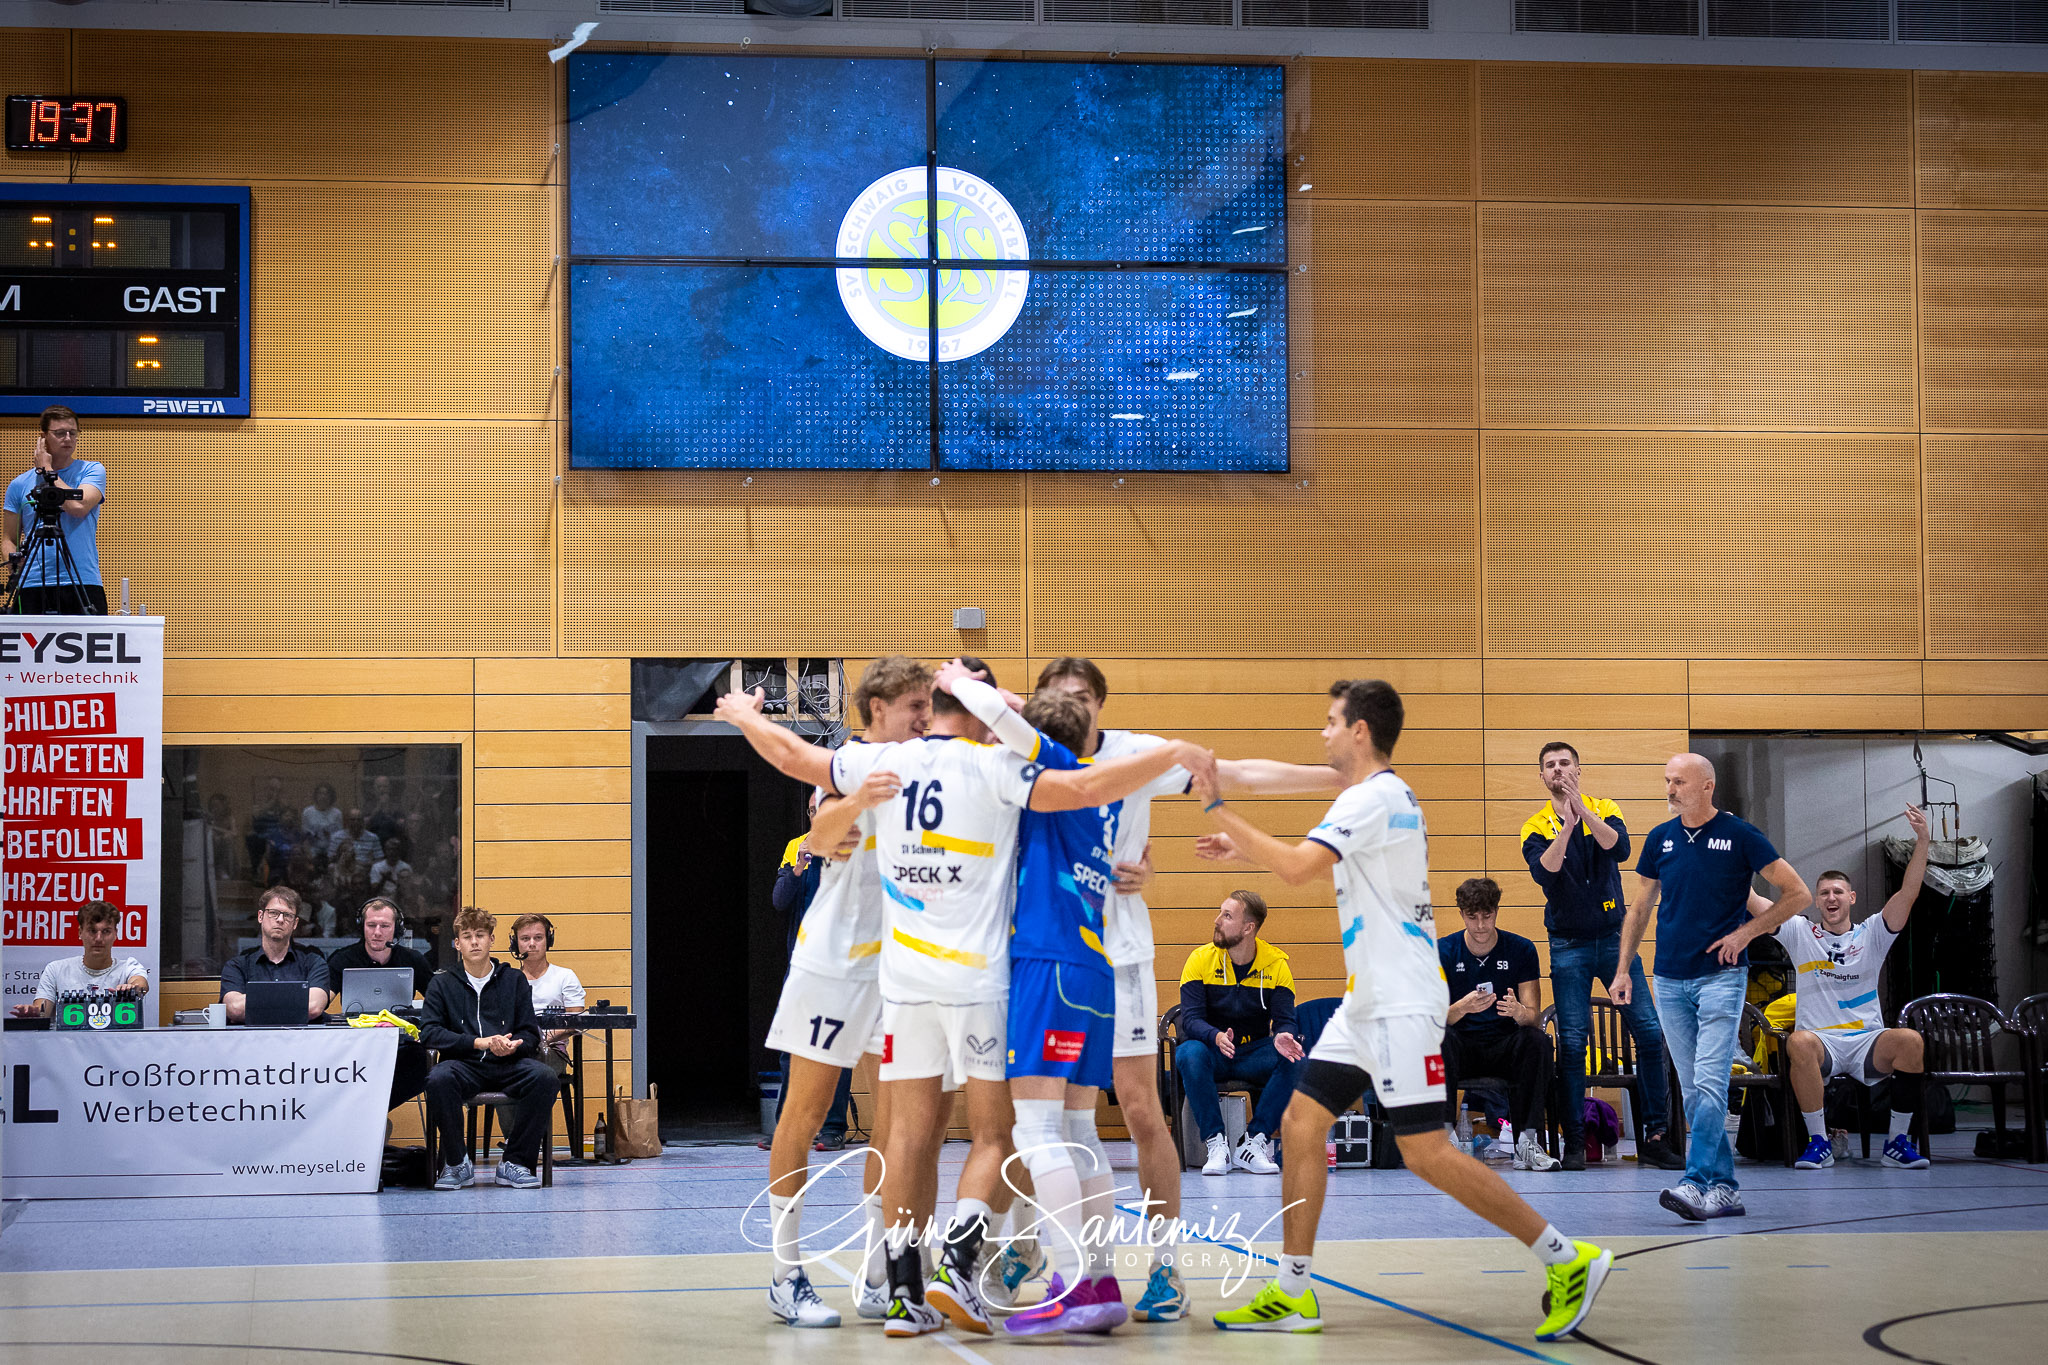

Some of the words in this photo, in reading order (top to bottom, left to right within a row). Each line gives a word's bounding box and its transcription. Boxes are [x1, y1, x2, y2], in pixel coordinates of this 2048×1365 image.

[845, 178, 908, 255] SCHWAIG
[952, 177, 1022, 300] VOLLEYBALL
[123, 286, 226, 314] GAST
[845, 274, 862, 298] SV
[143, 400, 226, 414] PEWETA
[20, 671, 139, 684] Werbetechnik
[4, 744, 129, 774] OTAPETEN
[902, 779, 943, 831] 16
[3, 827, 128, 859] BEFOLIEN
[1707, 838, 1732, 851] MM
[4, 871, 119, 902] HRZEUG-
[1072, 862, 1109, 897] SPEC
[1603, 899, 1616, 912] FW
[14, 970, 44, 981] Stra
[63, 1004, 84, 1026] 6
[115, 1002, 136, 1024] 6
[809, 1014, 845, 1051] 17
[84, 1060, 368, 1088] Großformatdruck
[83, 1097, 307, 1123] Werbetechnik
[232, 1159, 366, 1176] www.meysel.de
